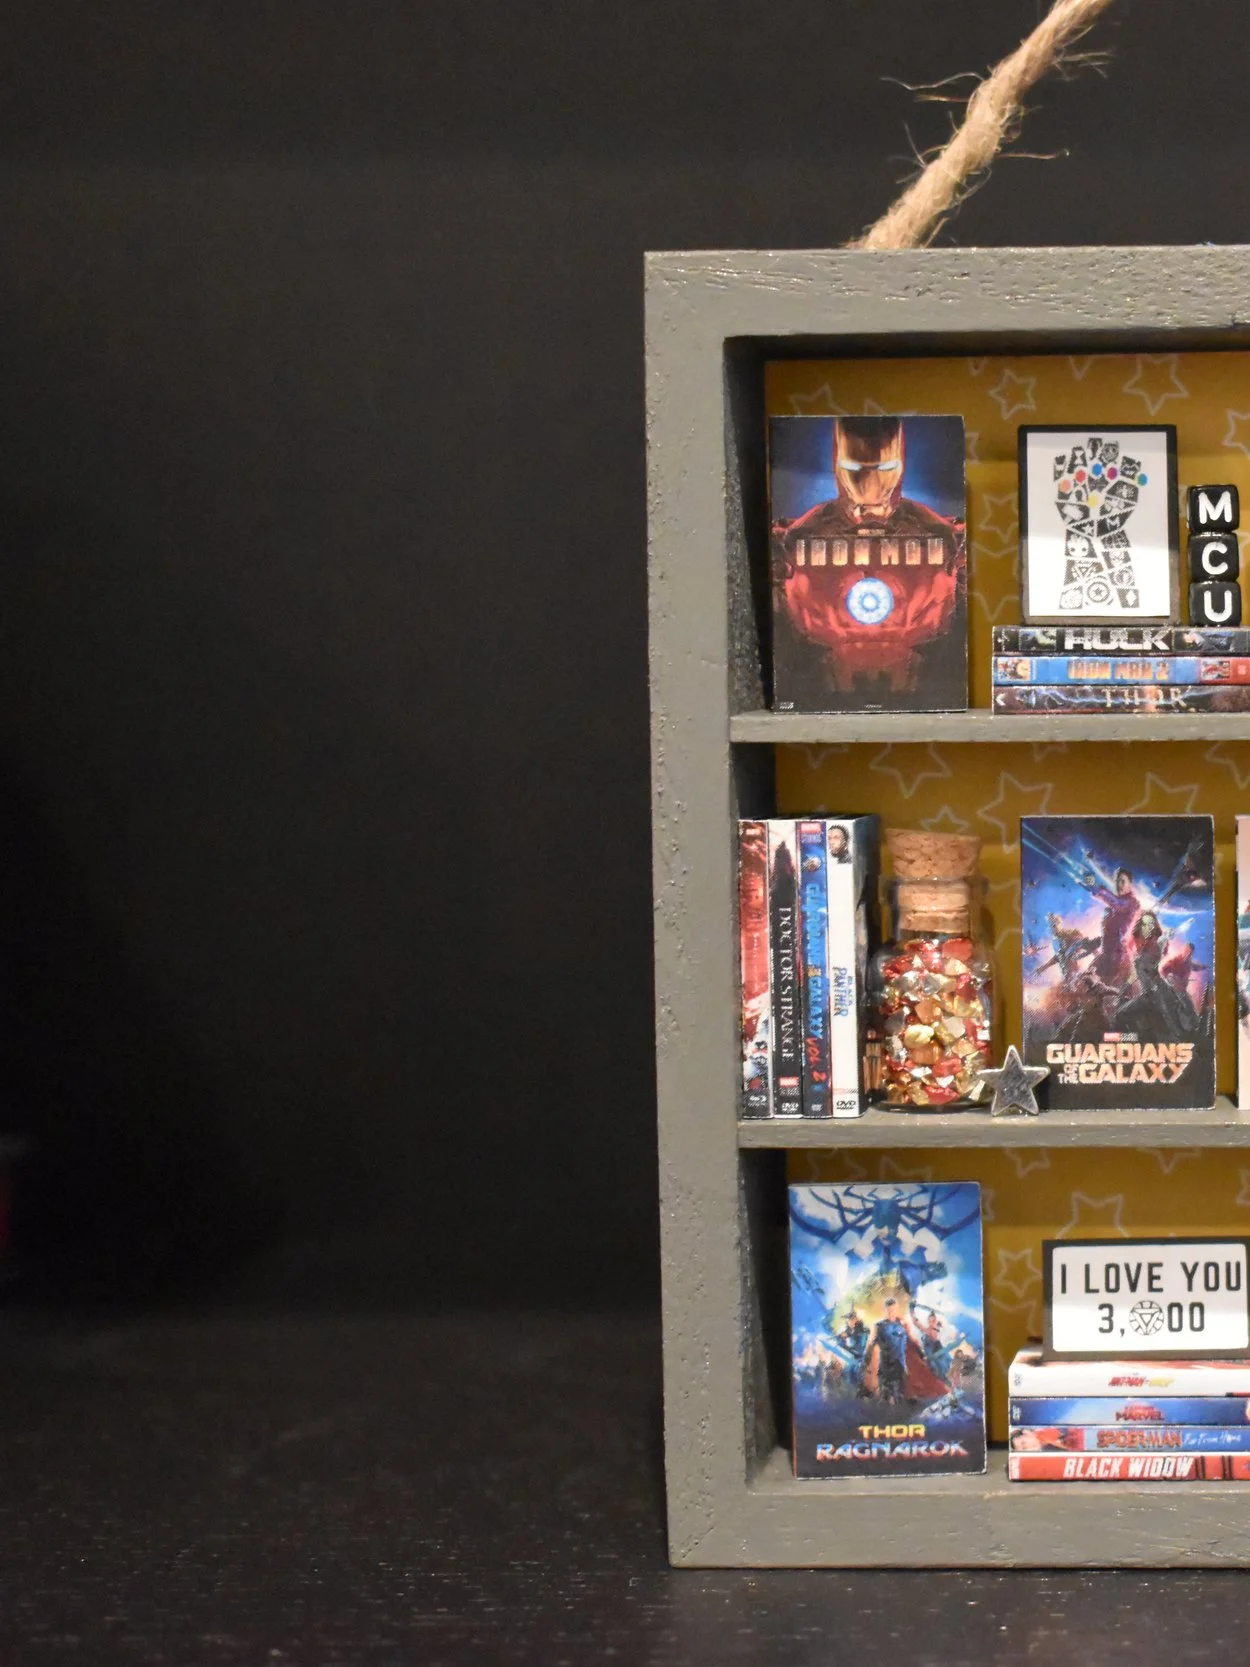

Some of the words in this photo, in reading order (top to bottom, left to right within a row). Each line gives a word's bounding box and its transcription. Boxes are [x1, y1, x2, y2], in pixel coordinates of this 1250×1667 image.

[796, 538, 870, 566] IRON
[880, 538, 944, 565] MAN
[1064, 627, 1170, 650] HULK
[1101, 687, 1188, 708] THOR
[778, 906, 794, 981] DOCTOR
[832, 966, 850, 1017] PANTHER
[808, 976, 824, 1040] GALAXY
[780, 985, 795, 1063] STRANGE
[1046, 1043, 1195, 1064] GUARDIANS
[1057, 1073, 1079, 1084] THE
[1078, 1063, 1188, 1084] GALAXY
[1060, 1264, 1067, 1294] I
[1084, 1262, 1164, 1294] LOVE
[1180, 1260, 1241, 1292] YOU
[858, 1424, 926, 1439] THOR
[1096, 1429, 1182, 1449] SPIDER-MAN
[815, 1440, 969, 1462] RAGNAROK
[1062, 1457, 1125, 1478] BLACK
[1127, 1456, 1195, 1478] WIDOW
